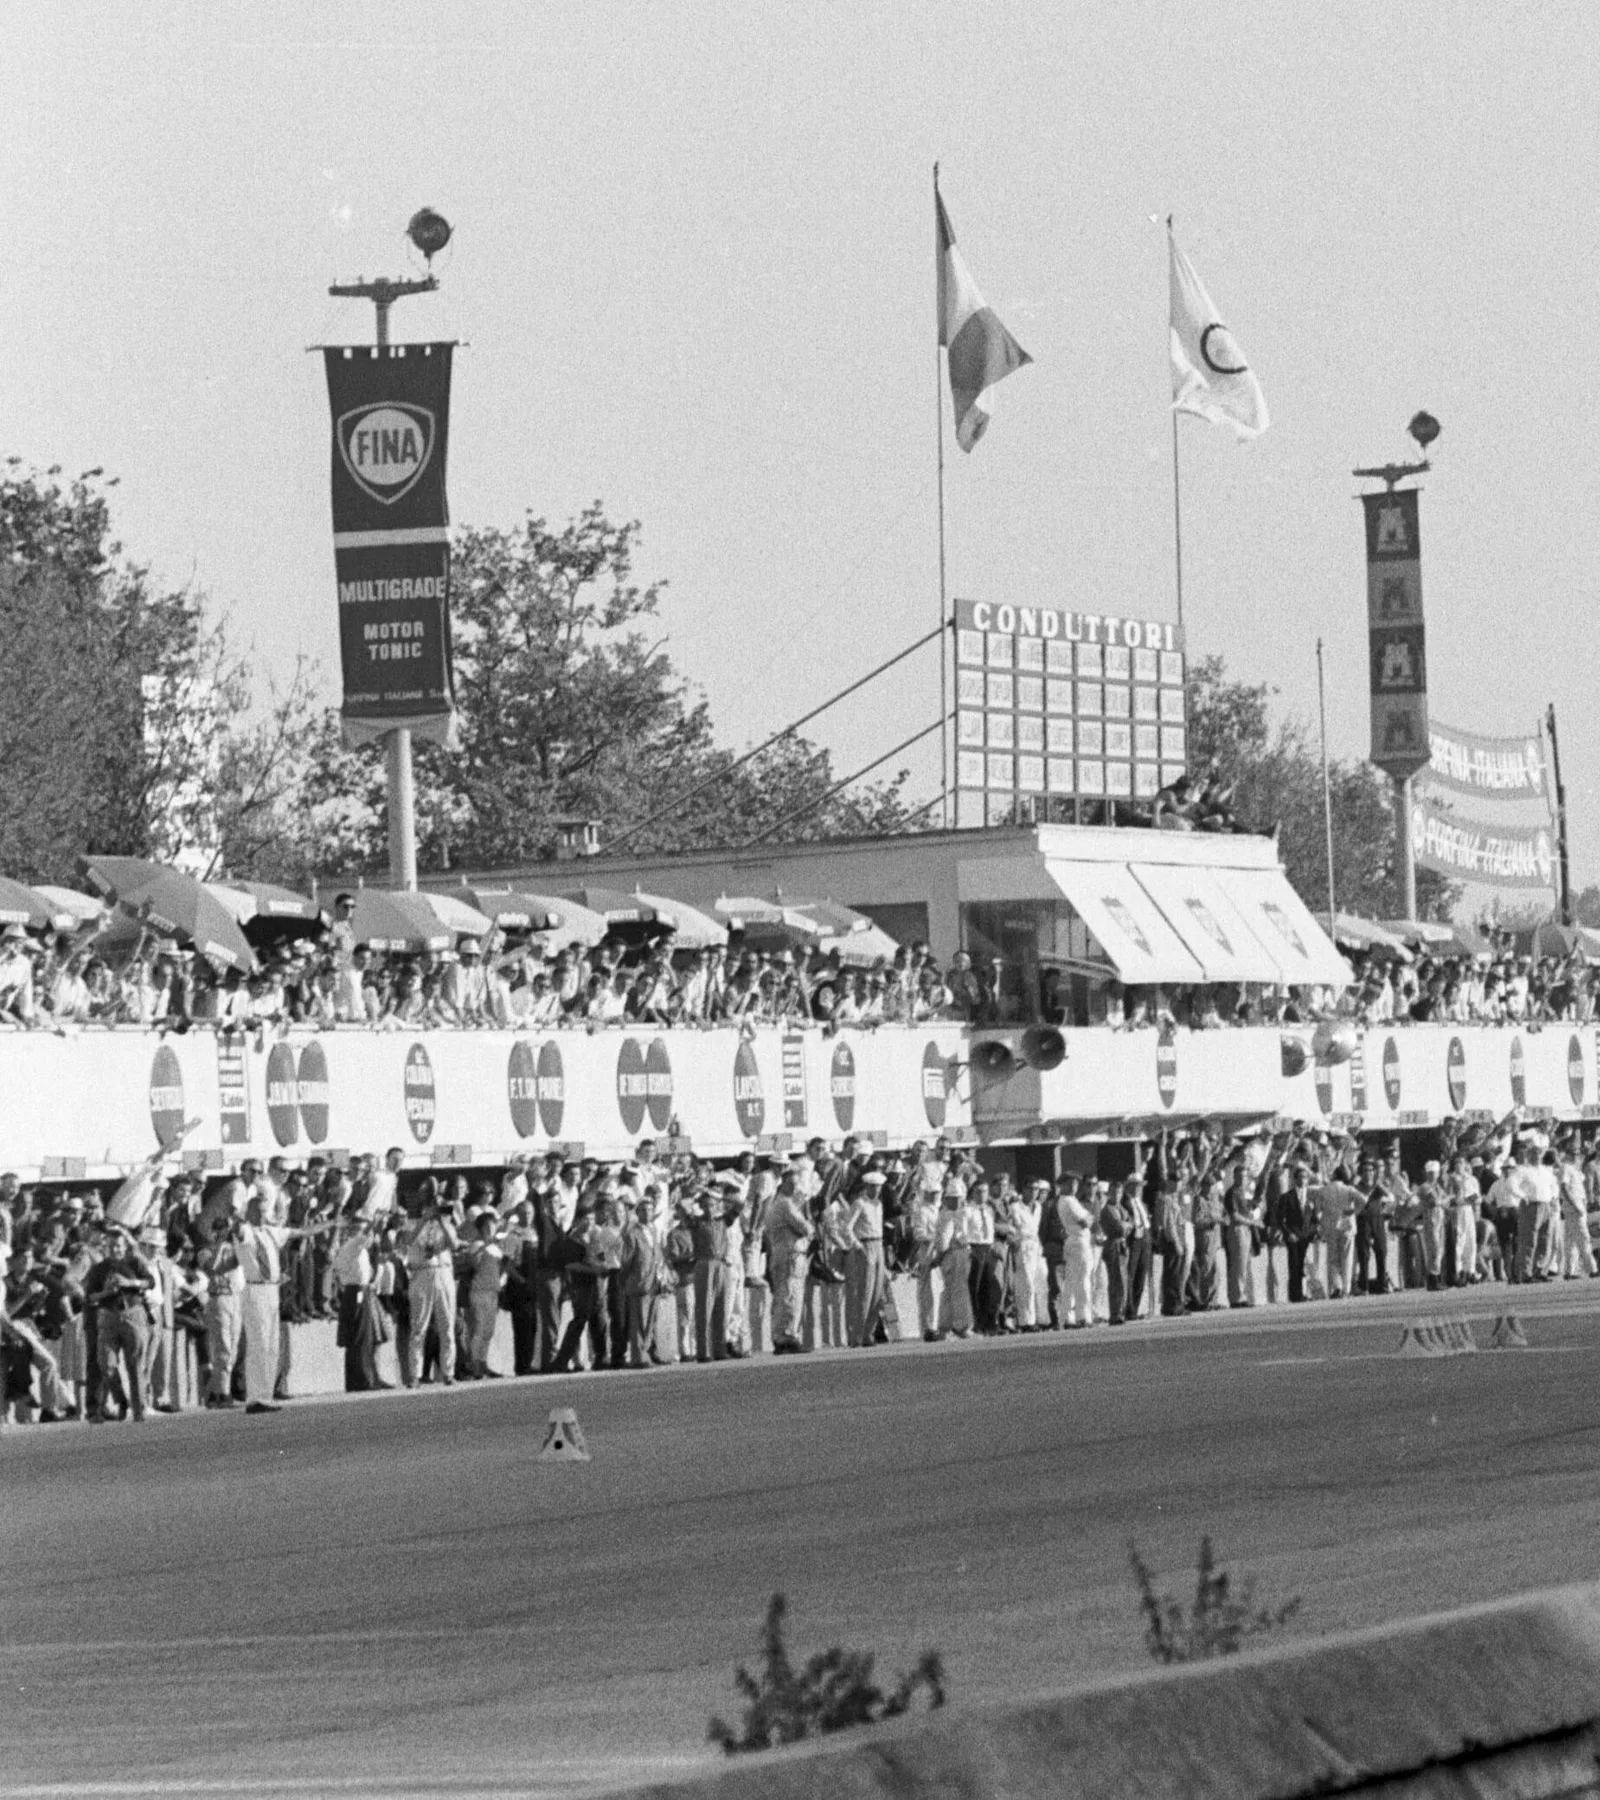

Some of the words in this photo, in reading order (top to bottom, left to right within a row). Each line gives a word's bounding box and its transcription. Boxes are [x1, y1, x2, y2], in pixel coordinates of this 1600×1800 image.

[356, 430, 419, 466] FINA
[340, 576, 447, 604] MULTIGRADE
[364, 621, 425, 640] MOTOR
[973, 602, 1173, 651] CONDUTTORI
[369, 643, 422, 661] TONIC
